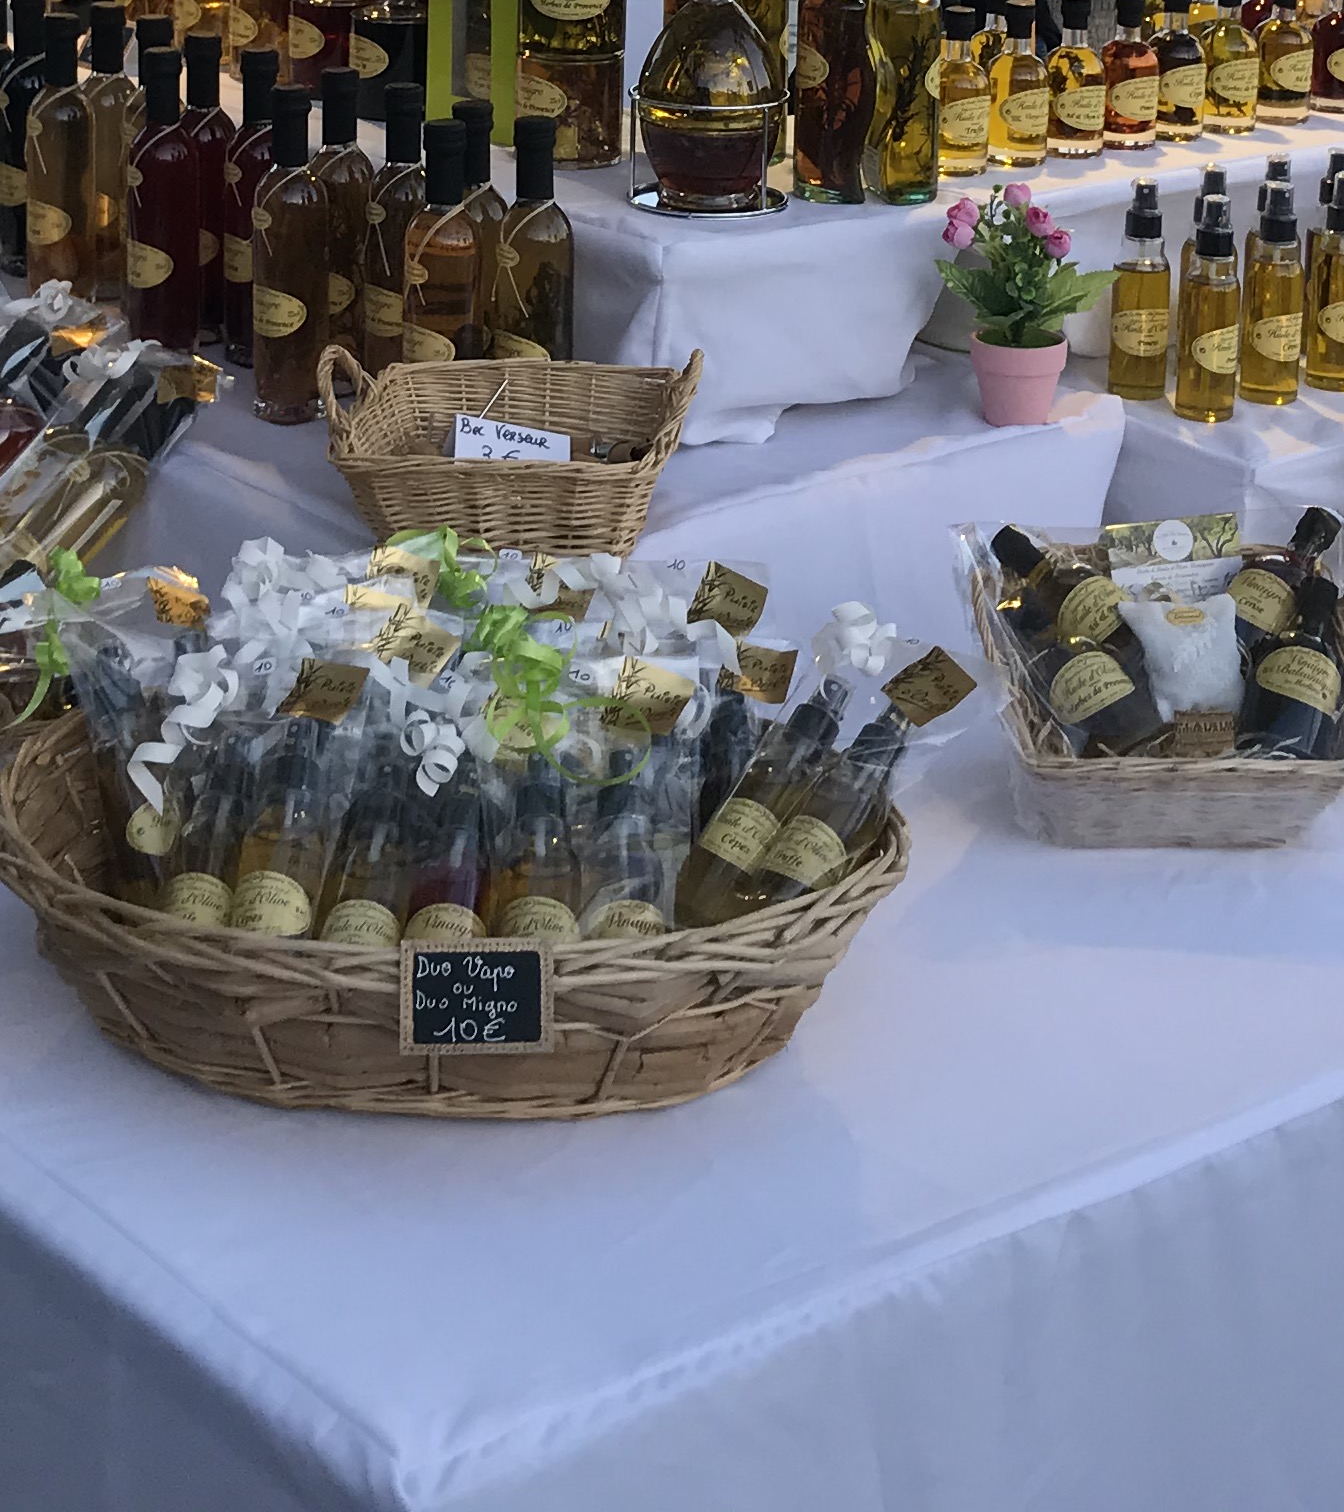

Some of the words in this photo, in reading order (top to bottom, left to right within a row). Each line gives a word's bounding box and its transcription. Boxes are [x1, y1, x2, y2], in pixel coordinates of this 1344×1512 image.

[325, 606, 345, 617] 10
[255, 660, 273, 673] 10
[569, 669, 591, 682] 10
[416, 955, 452, 978] Duo
[463, 955, 516, 991] Vapo
[452, 982, 474, 995] ou
[415, 990, 449, 1010] Duo
[462, 996, 518, 1018] Migno
